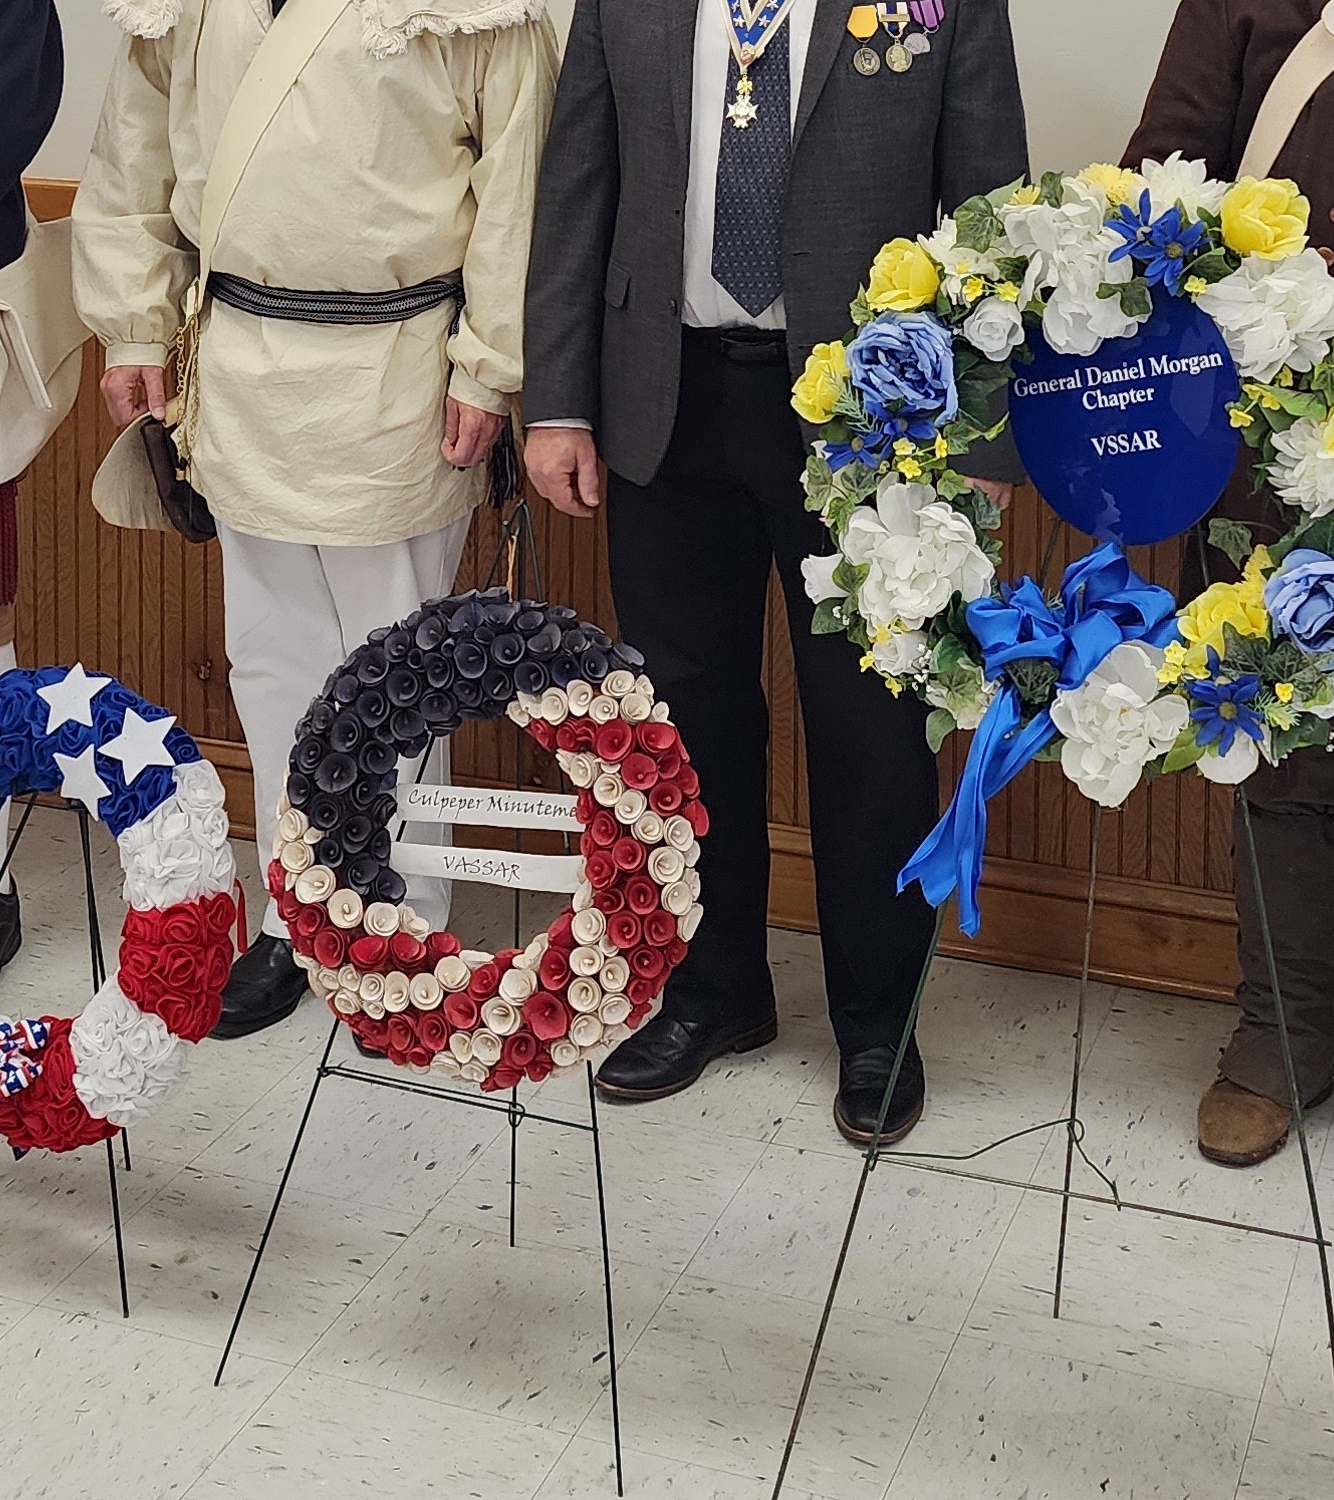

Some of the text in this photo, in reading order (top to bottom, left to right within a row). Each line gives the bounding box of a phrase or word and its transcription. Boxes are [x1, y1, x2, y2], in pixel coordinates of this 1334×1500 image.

[1014, 352, 1224, 397] General Daniel Morgan
[1082, 387, 1155, 410] Chapter
[1090, 430, 1162, 457] VSSAR
[408, 788, 579, 820] Culpeper Minuteme
[443, 855, 521, 883] VASSAR
